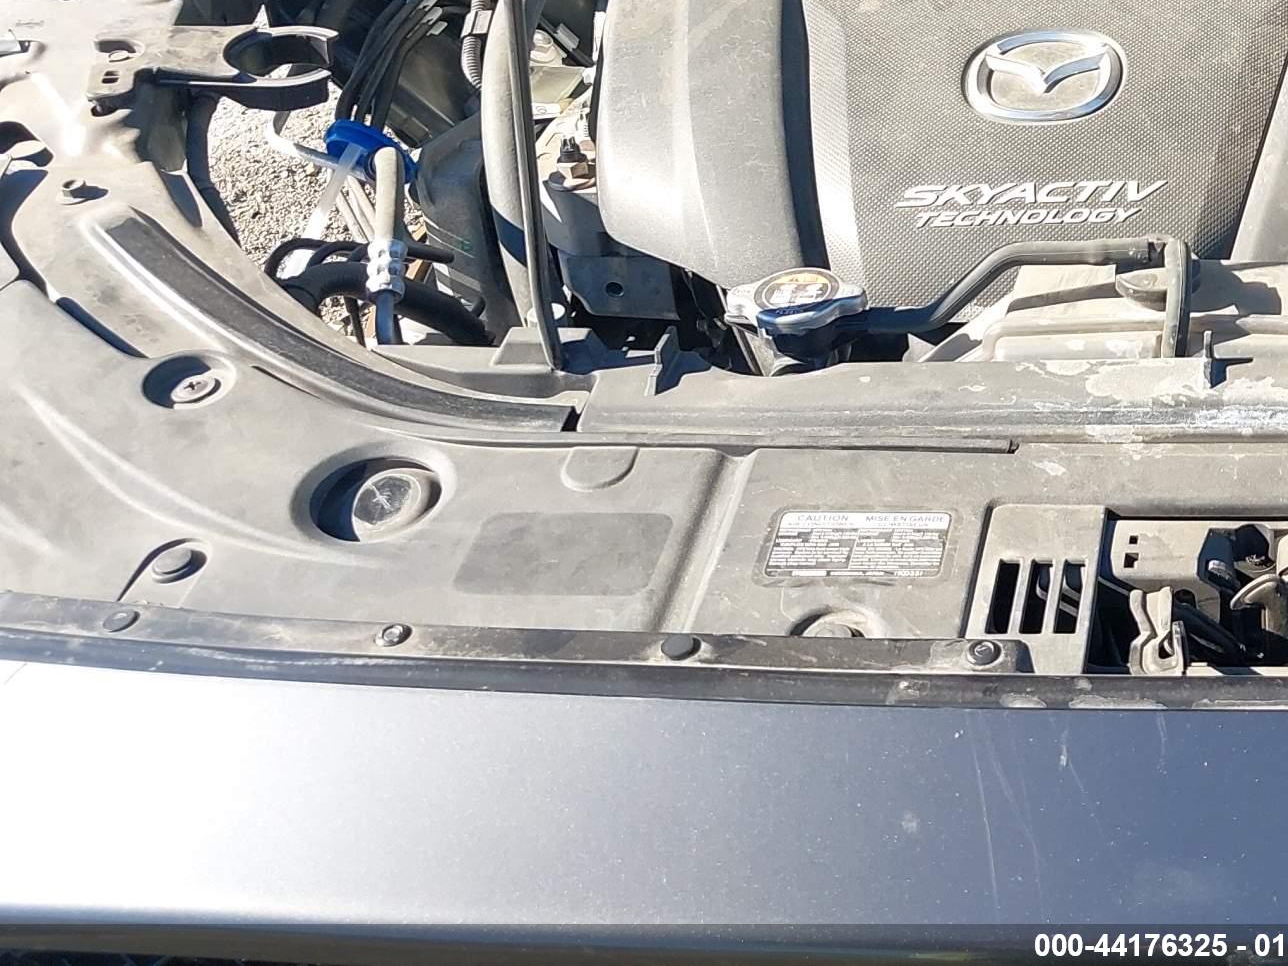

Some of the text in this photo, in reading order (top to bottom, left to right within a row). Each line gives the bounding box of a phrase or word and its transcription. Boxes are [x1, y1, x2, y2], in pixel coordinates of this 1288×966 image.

[896, 180, 1168, 208] SKYACTIV
[917, 208, 1142, 228] TECHNOLOGY
[797, 514, 849, 522] CAUTION
